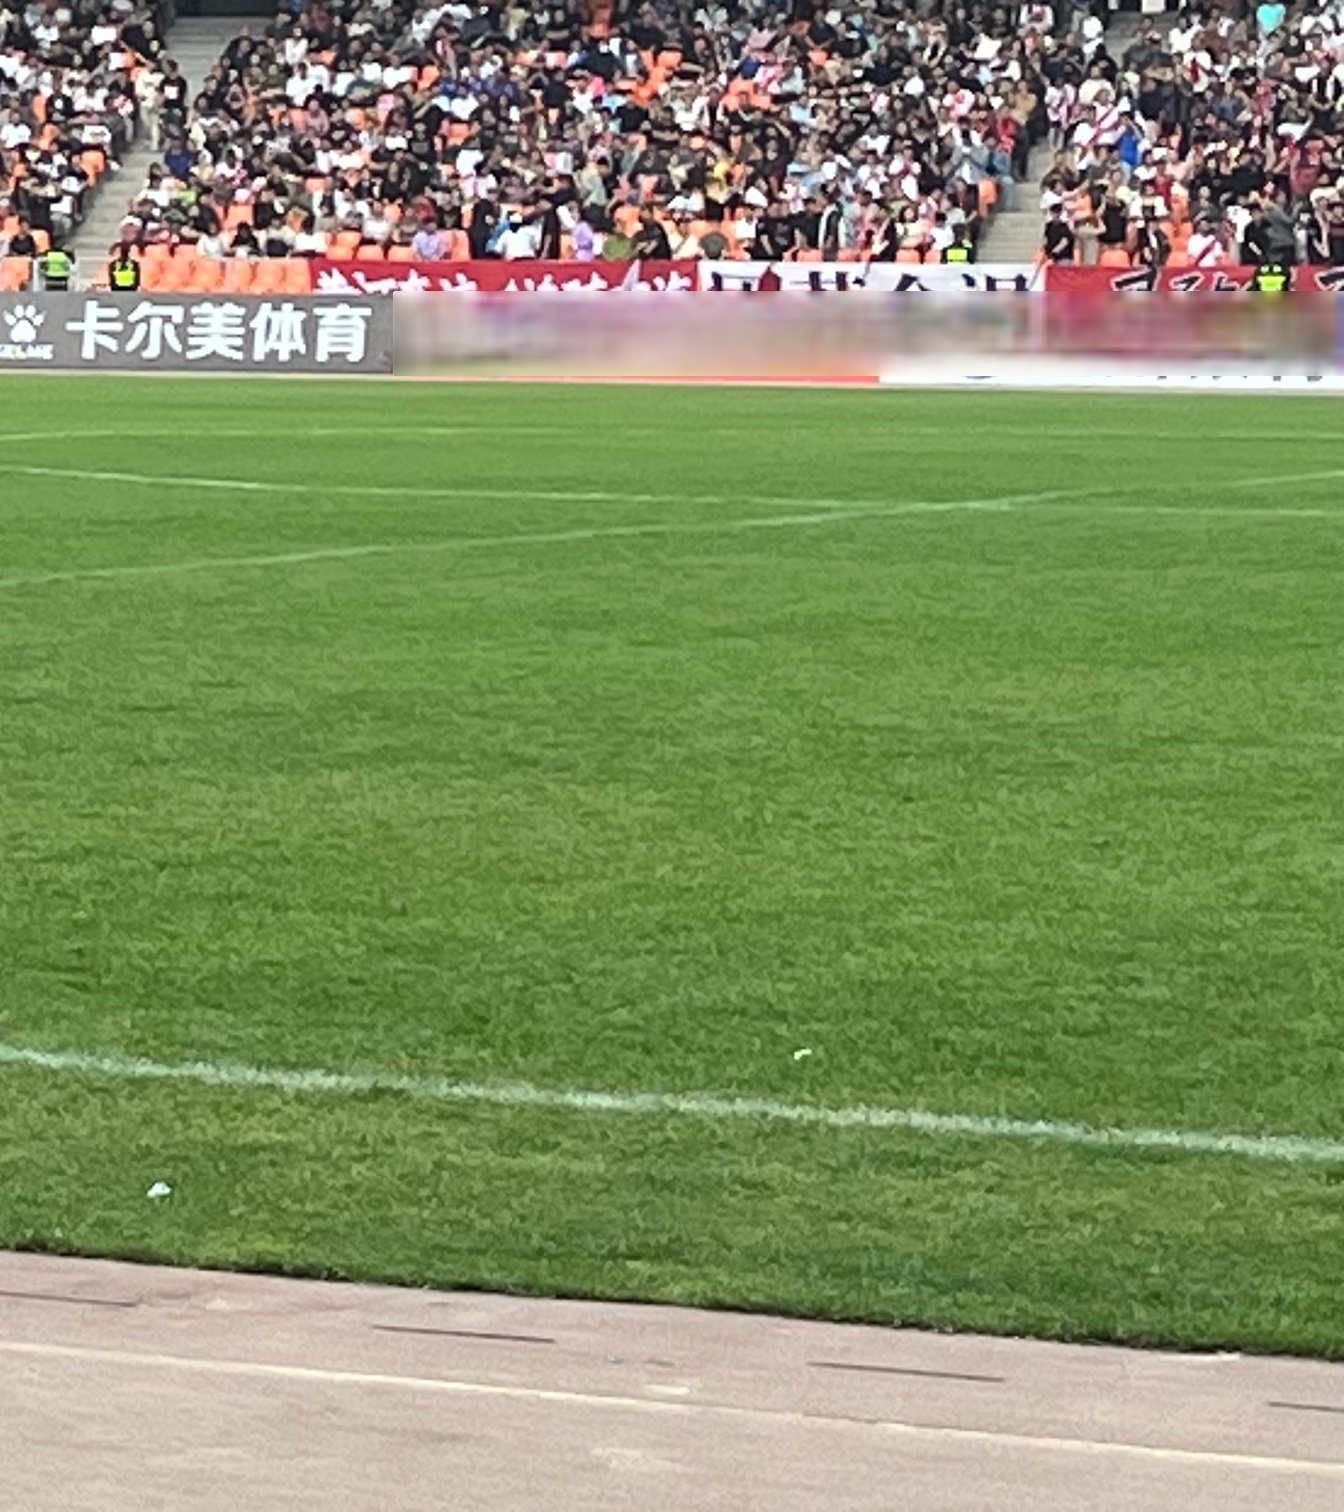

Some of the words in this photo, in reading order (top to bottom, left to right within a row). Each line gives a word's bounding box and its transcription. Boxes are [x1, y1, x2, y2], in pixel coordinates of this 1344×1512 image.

[65, 300, 371, 362] 卡尔美体育
